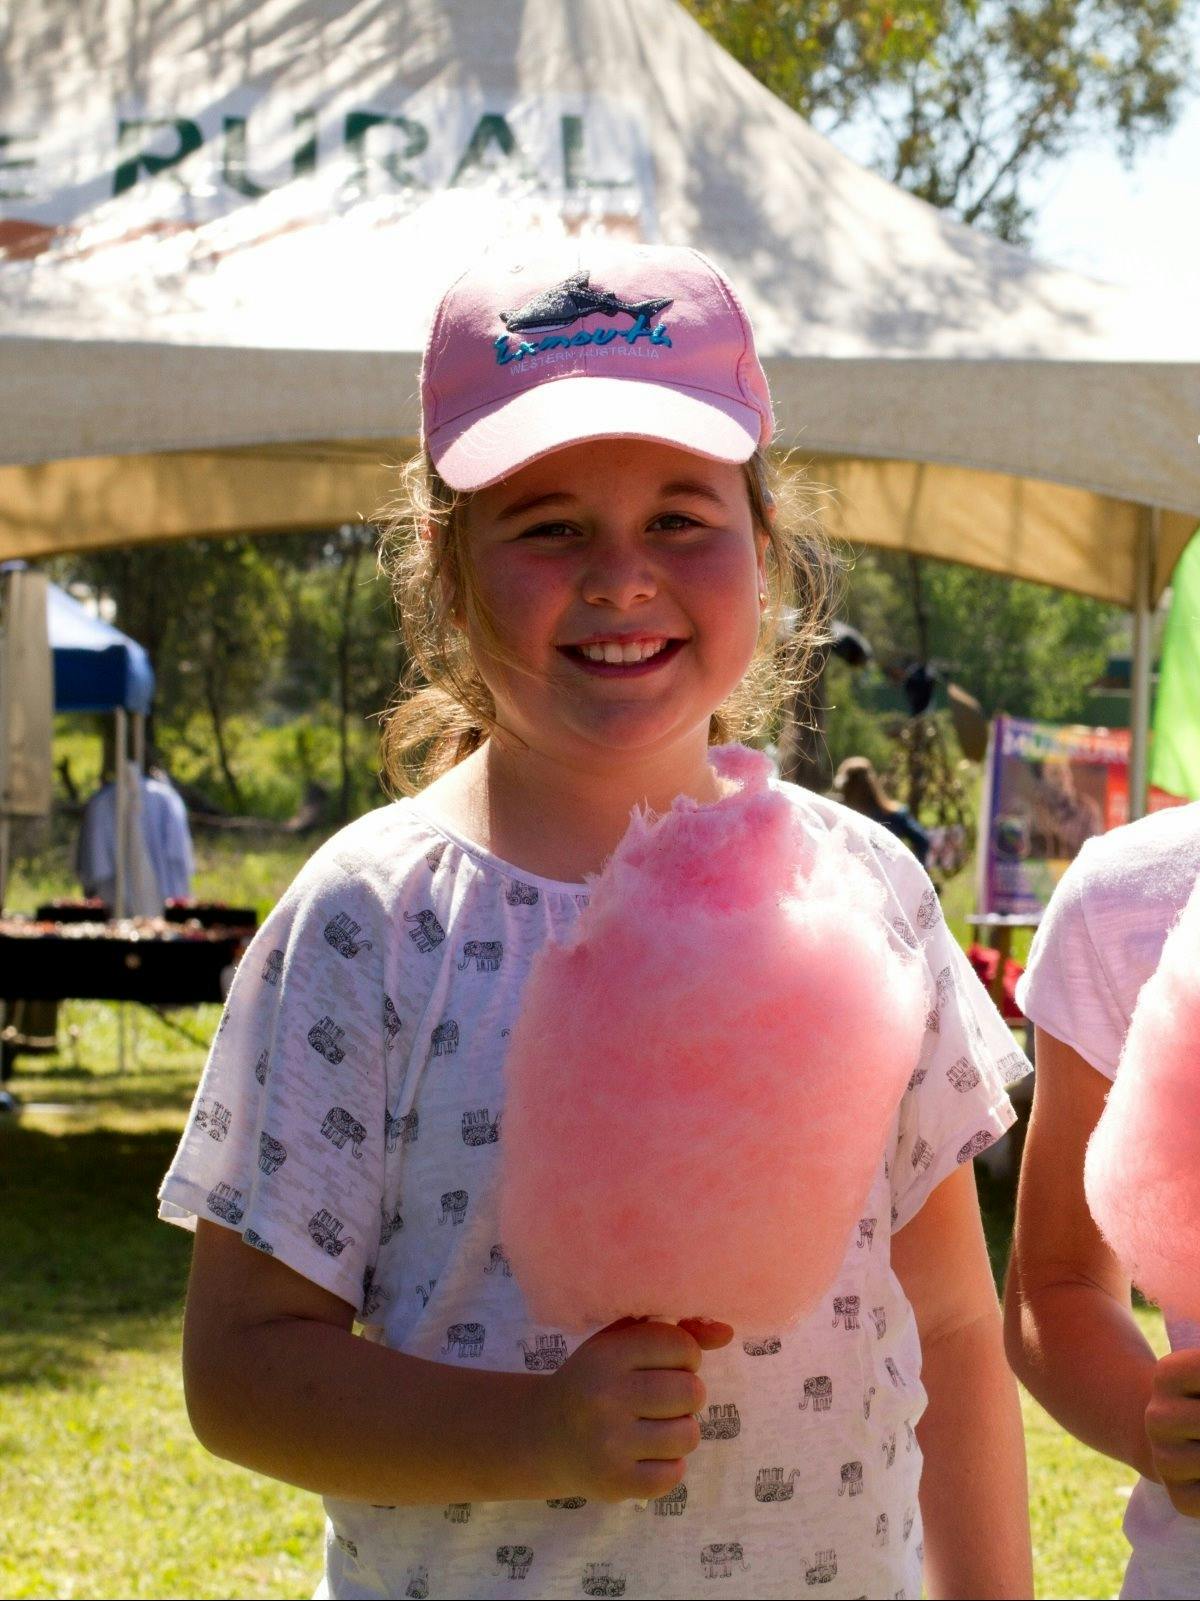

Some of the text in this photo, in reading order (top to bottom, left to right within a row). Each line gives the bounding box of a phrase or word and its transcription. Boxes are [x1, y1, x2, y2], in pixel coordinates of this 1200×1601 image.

[112, 110, 637, 199] RURAL
[511, 346, 660, 376] WESTERN AUSTRALIA
